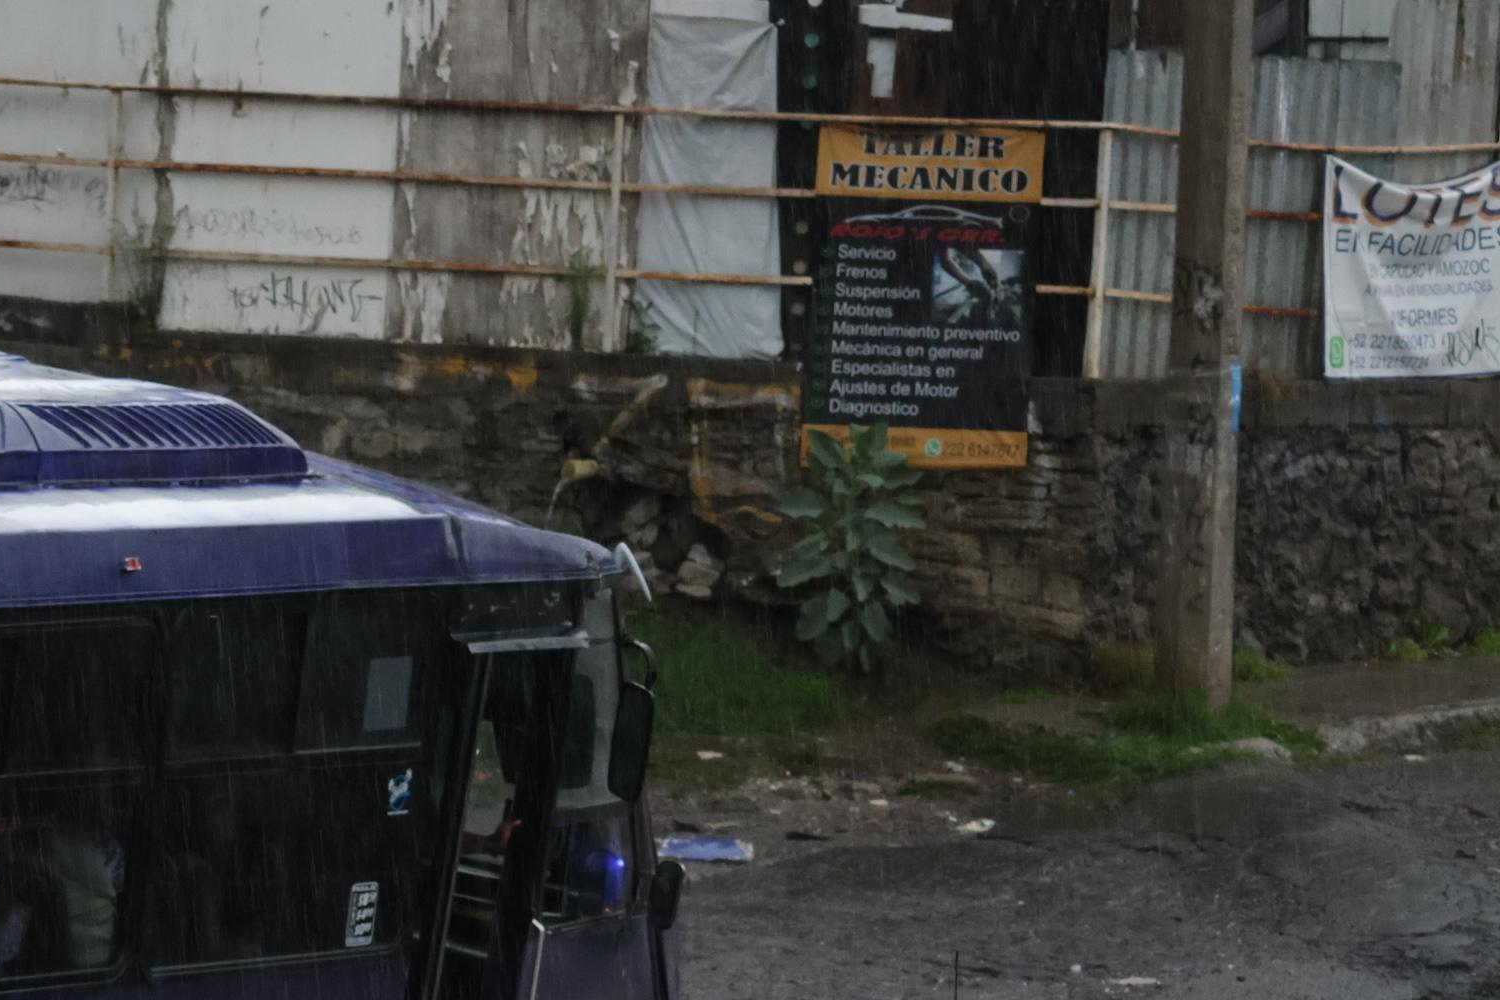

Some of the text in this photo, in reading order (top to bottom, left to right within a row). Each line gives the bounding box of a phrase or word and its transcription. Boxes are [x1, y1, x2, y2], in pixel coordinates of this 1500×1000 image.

[863, 132, 1005, 159] TALLER
[830, 162, 1029, 193] MECANICO
[838, 243, 897, 261] Servicio
[836, 263, 888, 280] Frenos
[835, 282, 921, 301] Suspensión
[833, 302, 893, 319] Motores
[1391, 308, 1459, 328] FORMES
[832, 321, 1021, 343] Mantenimiento preventivo
[831, 340, 984, 362] Mecánica en general
[831, 359, 956, 378] Especialistas en
[829, 379, 960, 399] Ajustes de Motor
[828, 398, 920, 418] Diagnostico
